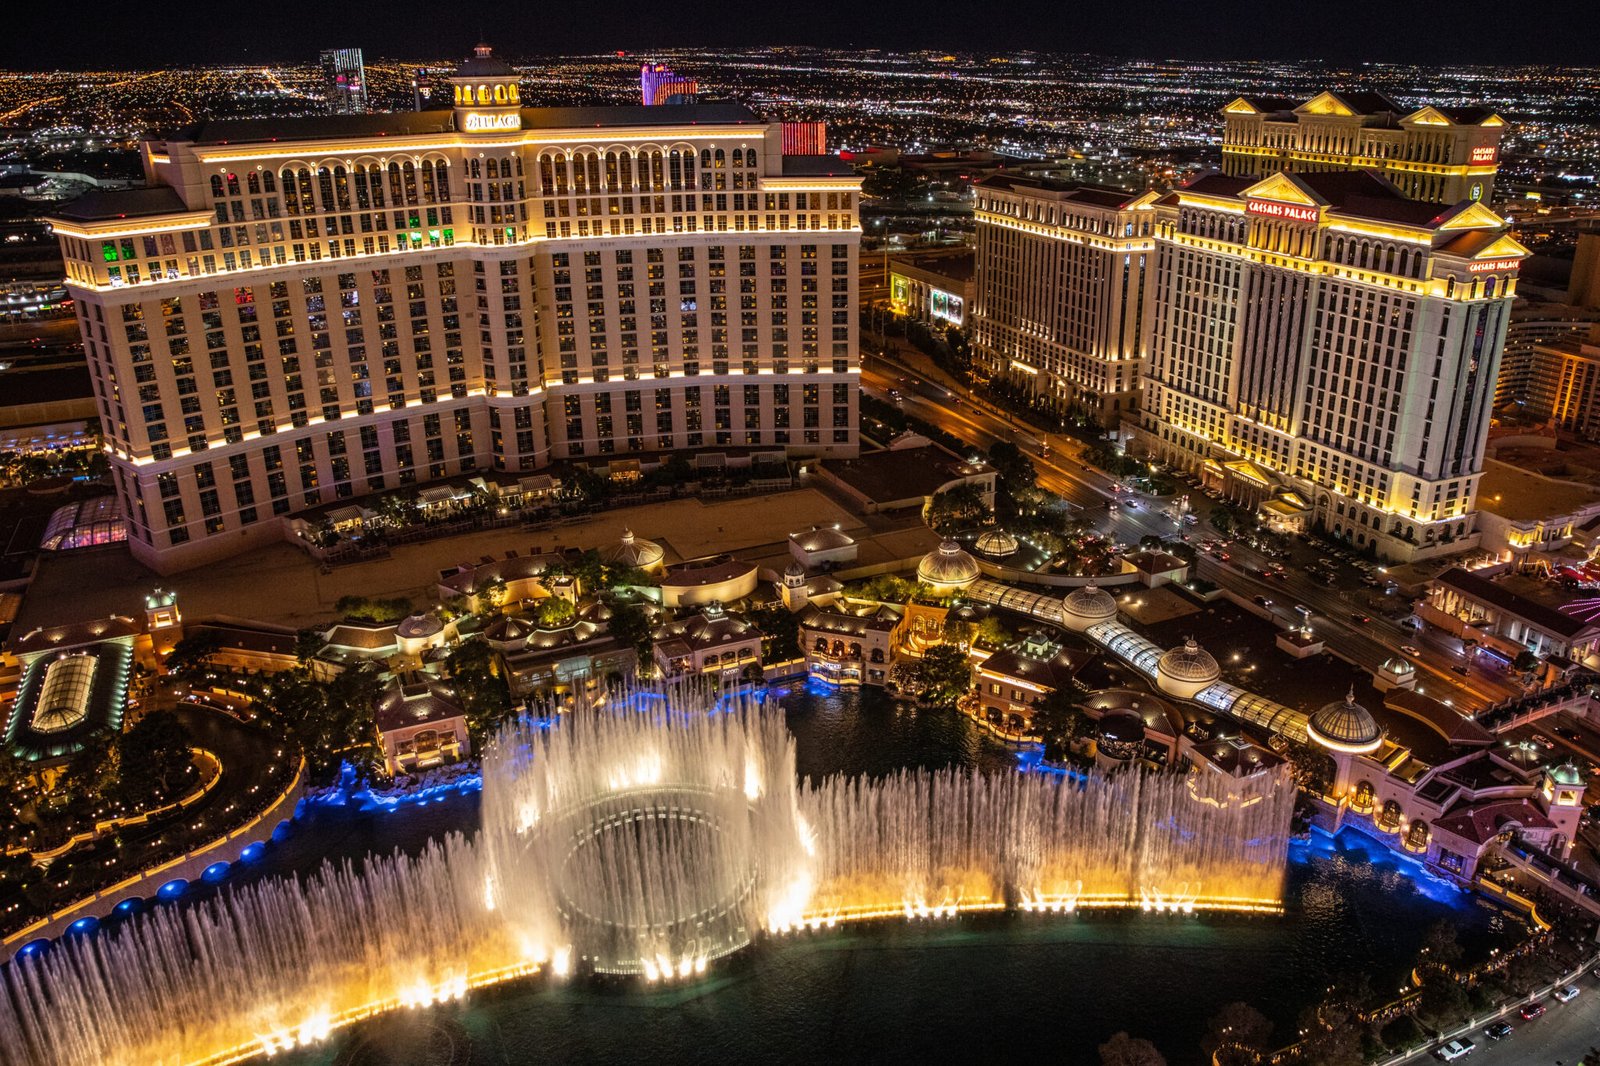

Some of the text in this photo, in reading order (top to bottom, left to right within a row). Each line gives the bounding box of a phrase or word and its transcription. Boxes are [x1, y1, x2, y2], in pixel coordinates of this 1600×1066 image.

[1248, 201, 1317, 222] CAESARS PALACE
[1469, 260, 1519, 272] CAESARS PALACE
